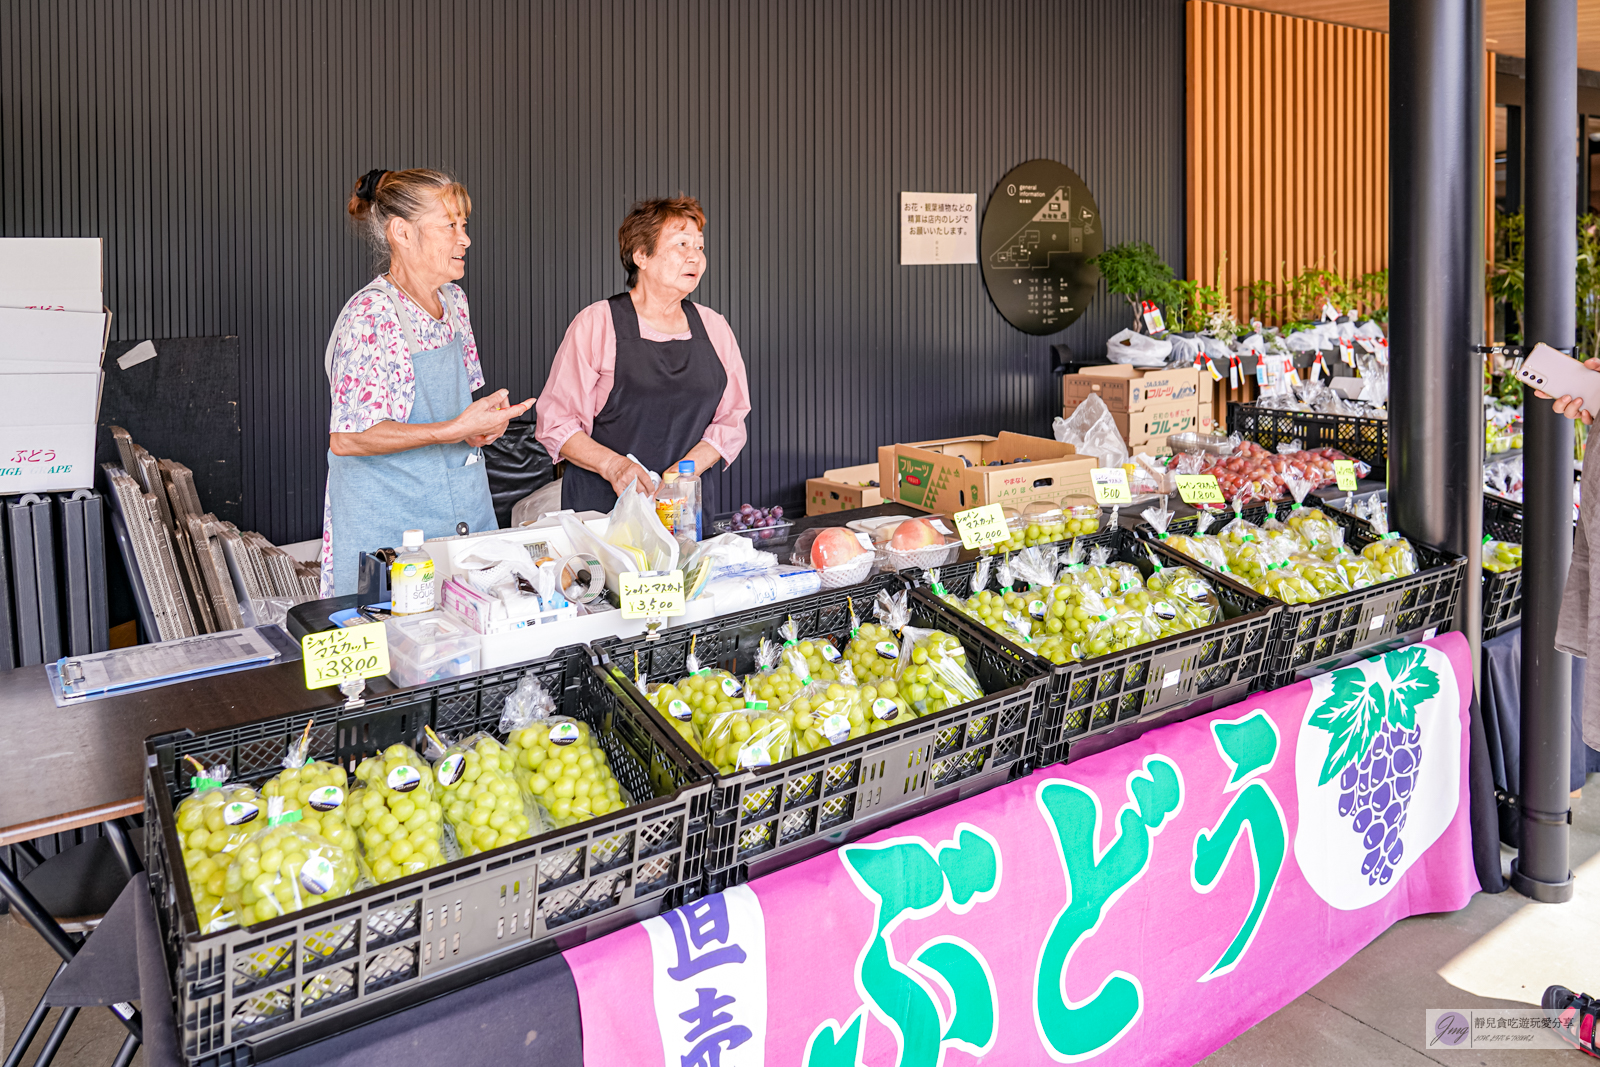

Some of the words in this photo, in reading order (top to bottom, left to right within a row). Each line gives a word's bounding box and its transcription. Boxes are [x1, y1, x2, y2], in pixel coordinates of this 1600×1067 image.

[904, 203, 972, 212] お花・観葉植物などの
[908, 215, 969, 224] 精算は店内のレジで
[909, 227, 967, 236] お願いいたします。
[1148, 386, 1174, 398] フルーツ
[1150, 417, 1191, 435] フルーツ
[10, 450, 56, 463] ぶどう
[900, 459, 929, 477] フルーツ
[1004, 476, 1026, 485] やまなし
[998, 486, 1033, 498] JAりほく
[966, 514, 995, 529] マスカット
[307, 631, 350, 649] シャイン
[315, 636, 374, 658] マスカット
[804, 709, 1287, 1067] ぶどう
